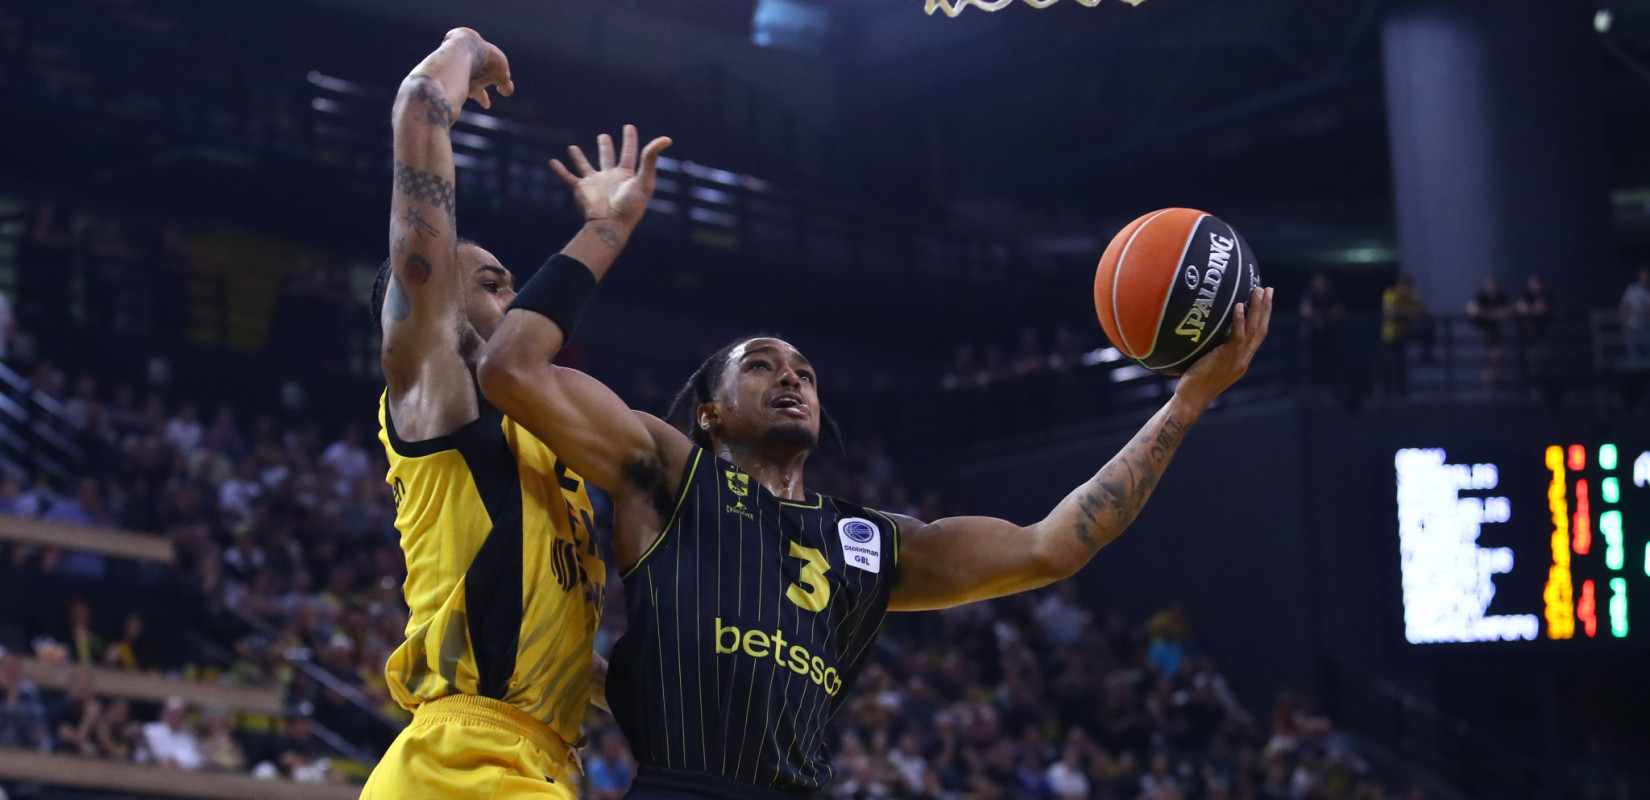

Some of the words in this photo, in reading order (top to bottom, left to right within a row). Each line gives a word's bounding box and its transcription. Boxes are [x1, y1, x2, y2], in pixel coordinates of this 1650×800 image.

[1175, 232, 1235, 342] SPALDING
[785, 540, 831, 613] 3
[855, 555, 870, 566] GBL
